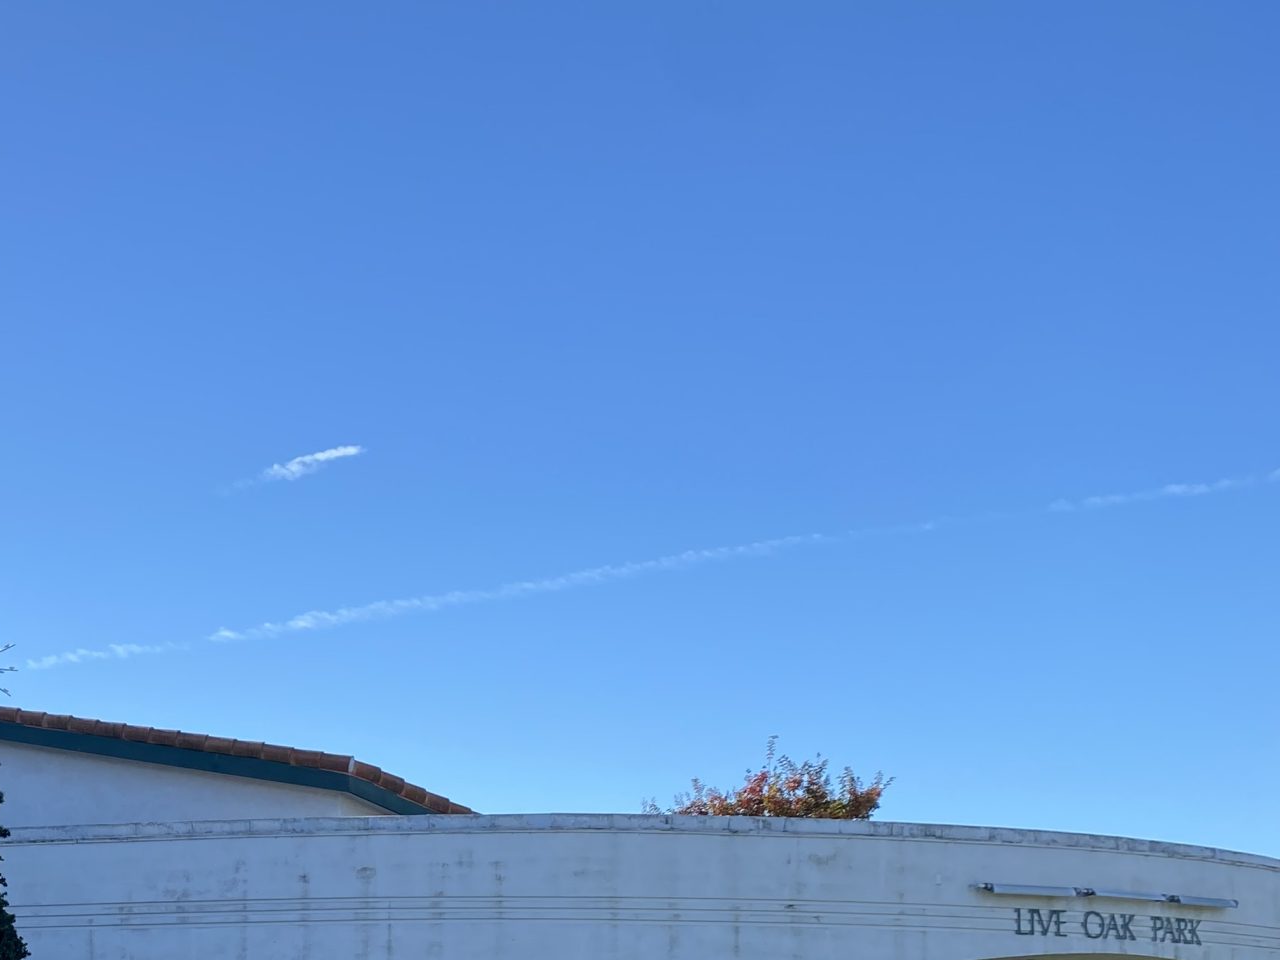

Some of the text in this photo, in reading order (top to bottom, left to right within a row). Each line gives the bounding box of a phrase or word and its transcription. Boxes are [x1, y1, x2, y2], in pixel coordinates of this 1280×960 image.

[1014, 908, 1202, 946] LIVE OAK PARK
